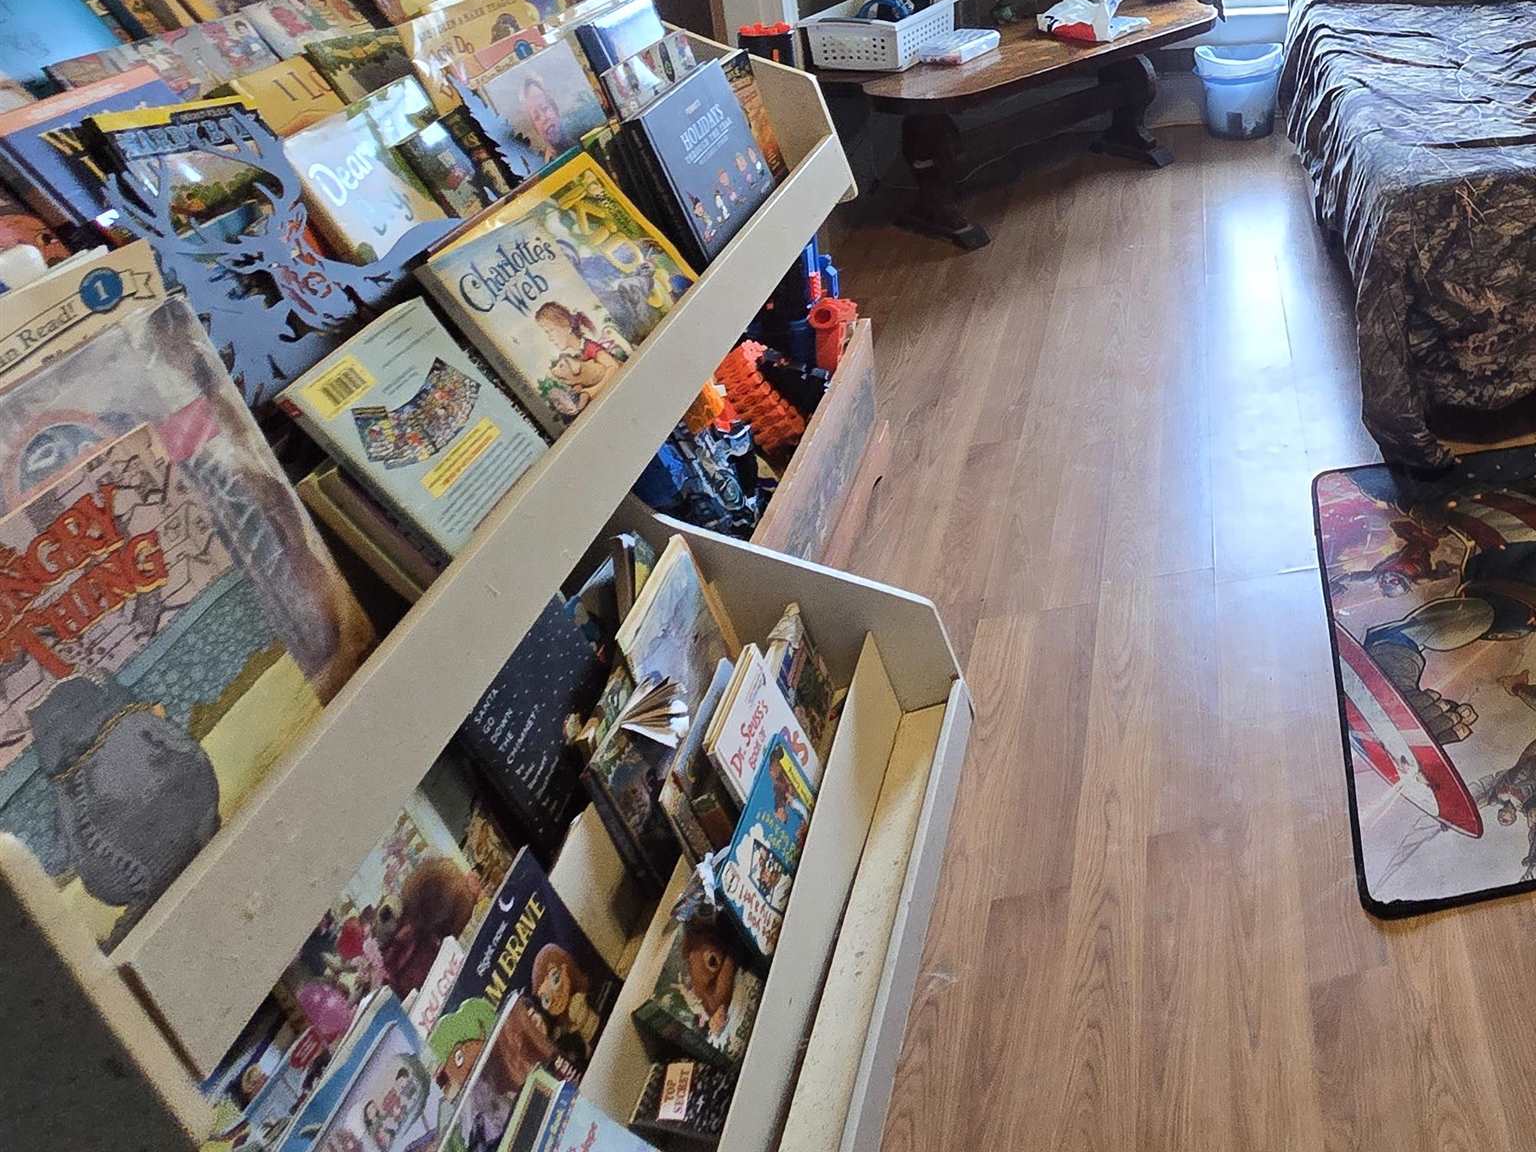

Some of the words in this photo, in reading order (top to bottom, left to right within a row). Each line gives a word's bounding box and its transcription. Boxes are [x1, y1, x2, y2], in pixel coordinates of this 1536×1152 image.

[679, 102, 727, 153] HOLIDAYS
[308, 144, 377, 208] Dear
[93, 279, 110, 302] 1
[458, 236, 558, 314] Charlotte's
[502, 269, 550, 318] Web
[16, 302, 79, 352] Read!
[473, 688, 500, 726] SANTA
[482, 717, 496, 736] GO
[489, 706, 514, 746] DOWN
[497, 731, 515, 753] THE
[729, 746, 748, 779] Dr.
[740, 699, 769, 747] Seuss's
[497, 891, 547, 978] BRAVE
[663, 1079, 676, 1104] TOP
[673, 1069, 693, 1114] SECRET
